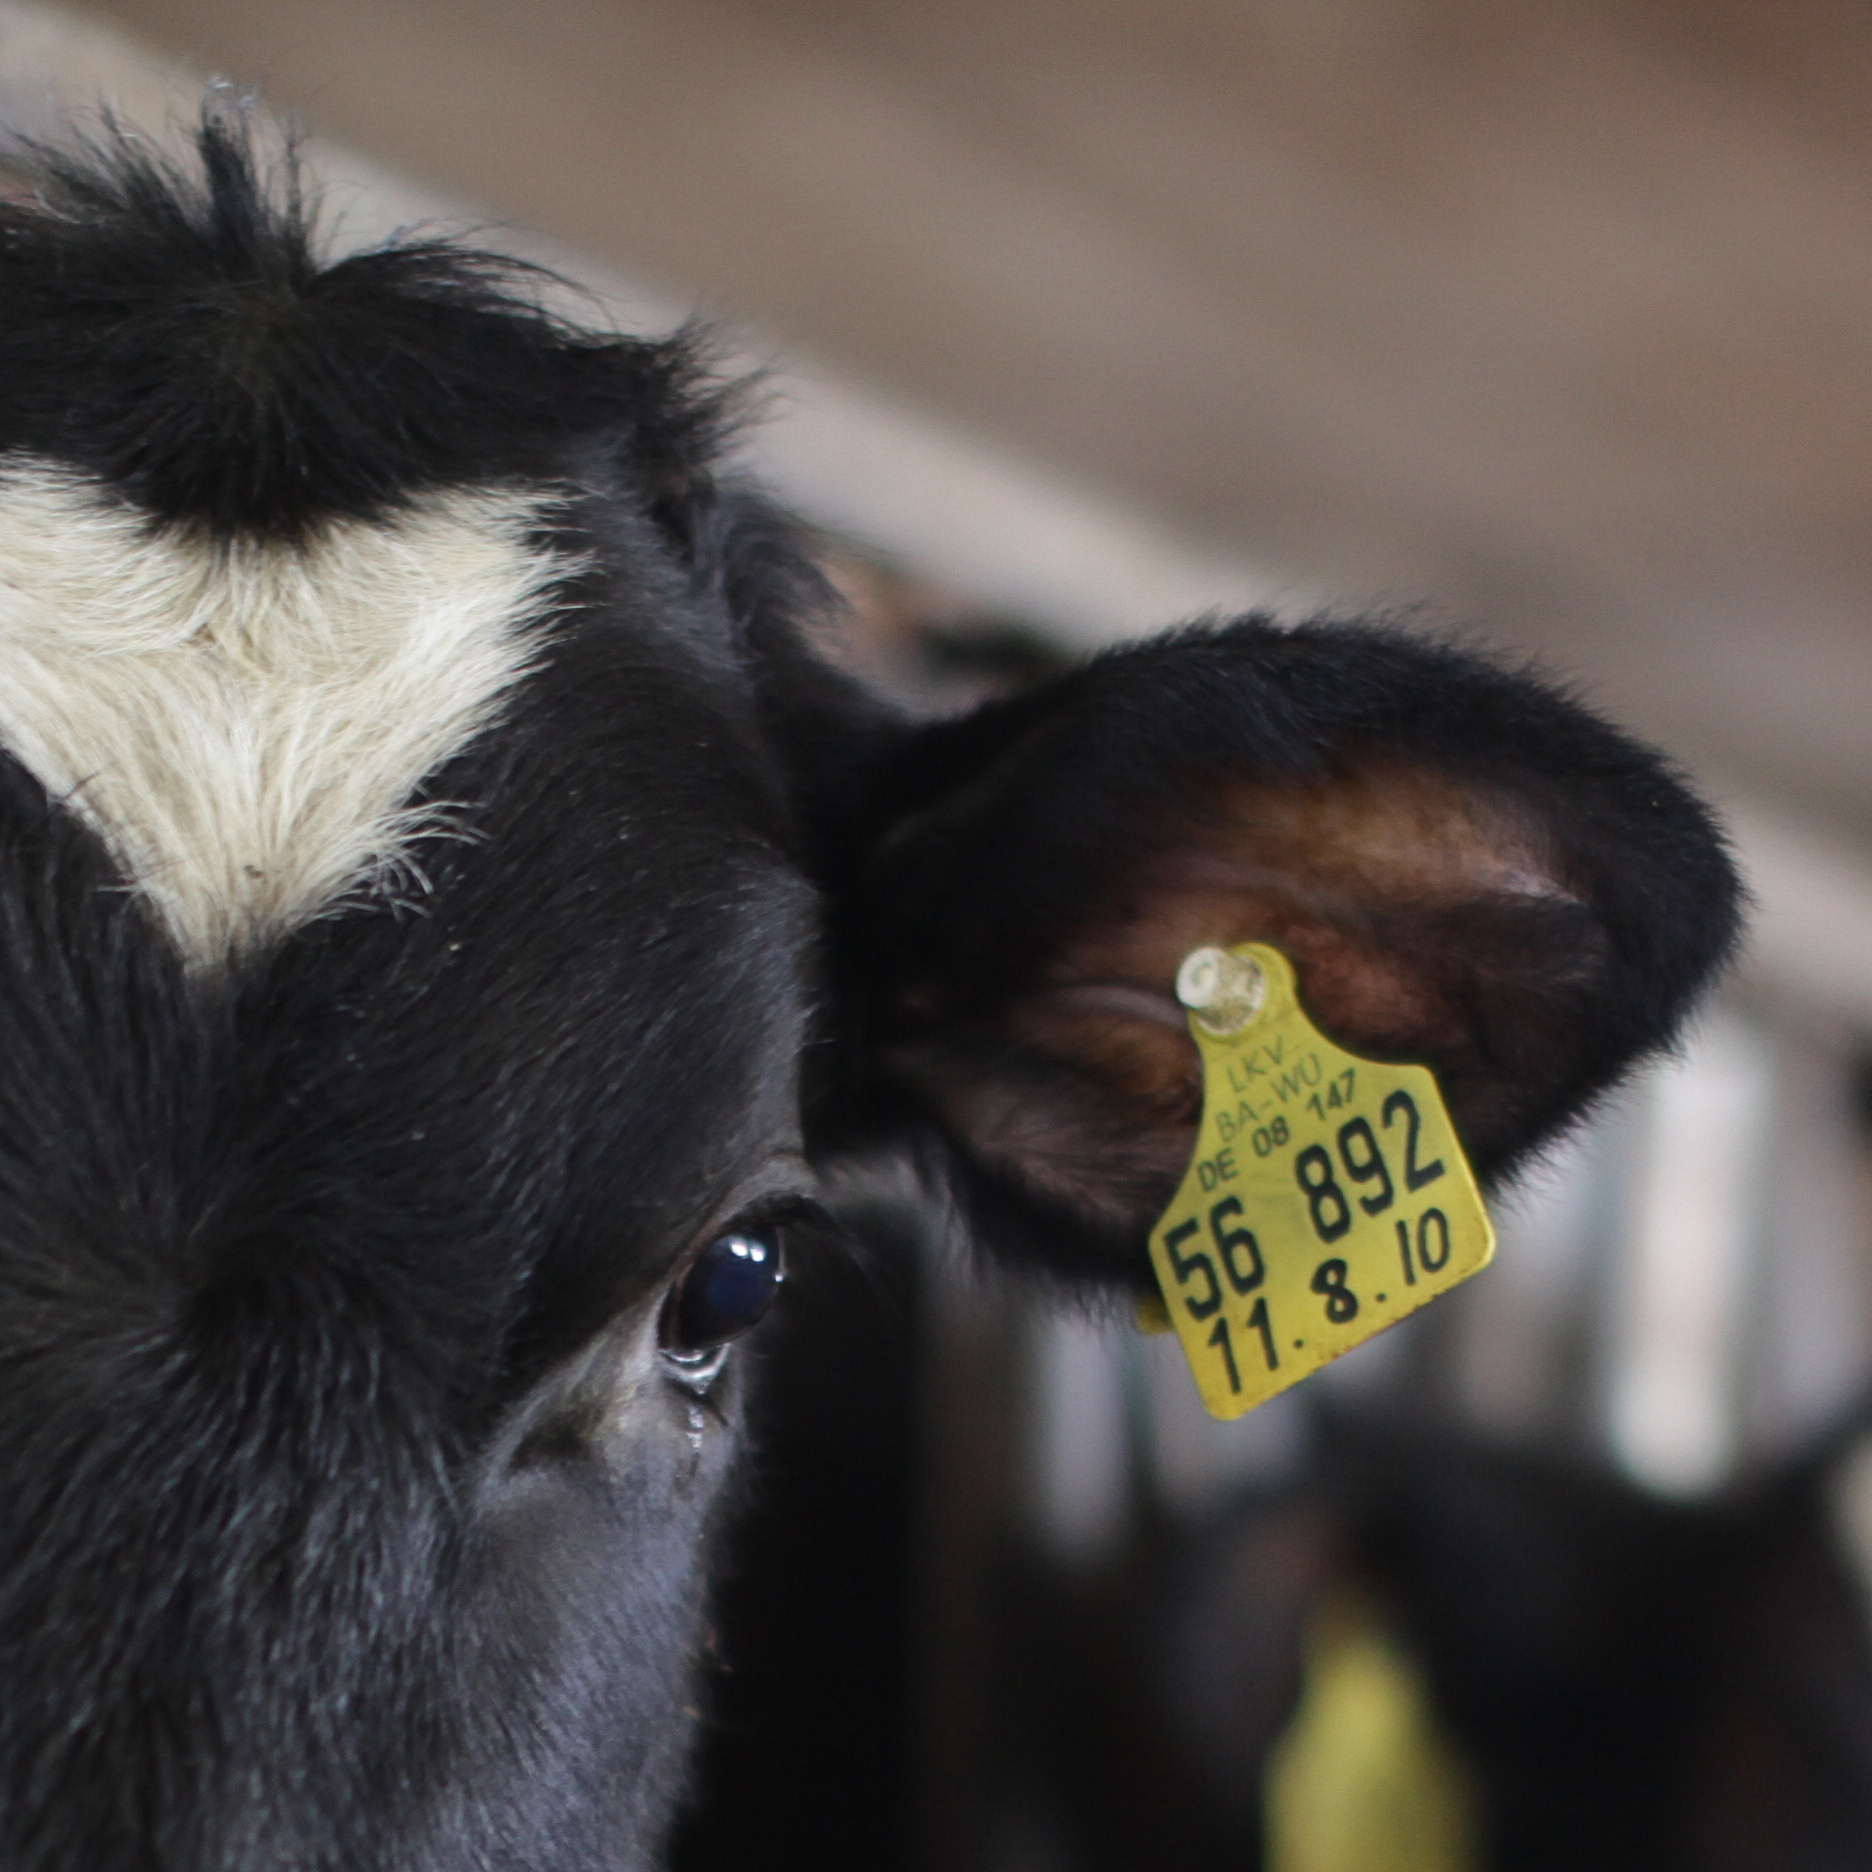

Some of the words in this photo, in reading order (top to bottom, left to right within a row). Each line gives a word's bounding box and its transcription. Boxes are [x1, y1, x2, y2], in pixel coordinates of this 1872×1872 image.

[1228, 1035, 1284, 1093] LKV
[1197, 1151, 1239, 1193] DE
[1252, 1116, 1291, 1159] 08
[1306, 1068, 1357, 1121] 147
[1163, 1196, 1266, 1322] 56
[1295, 1089, 1446, 1244] 892
